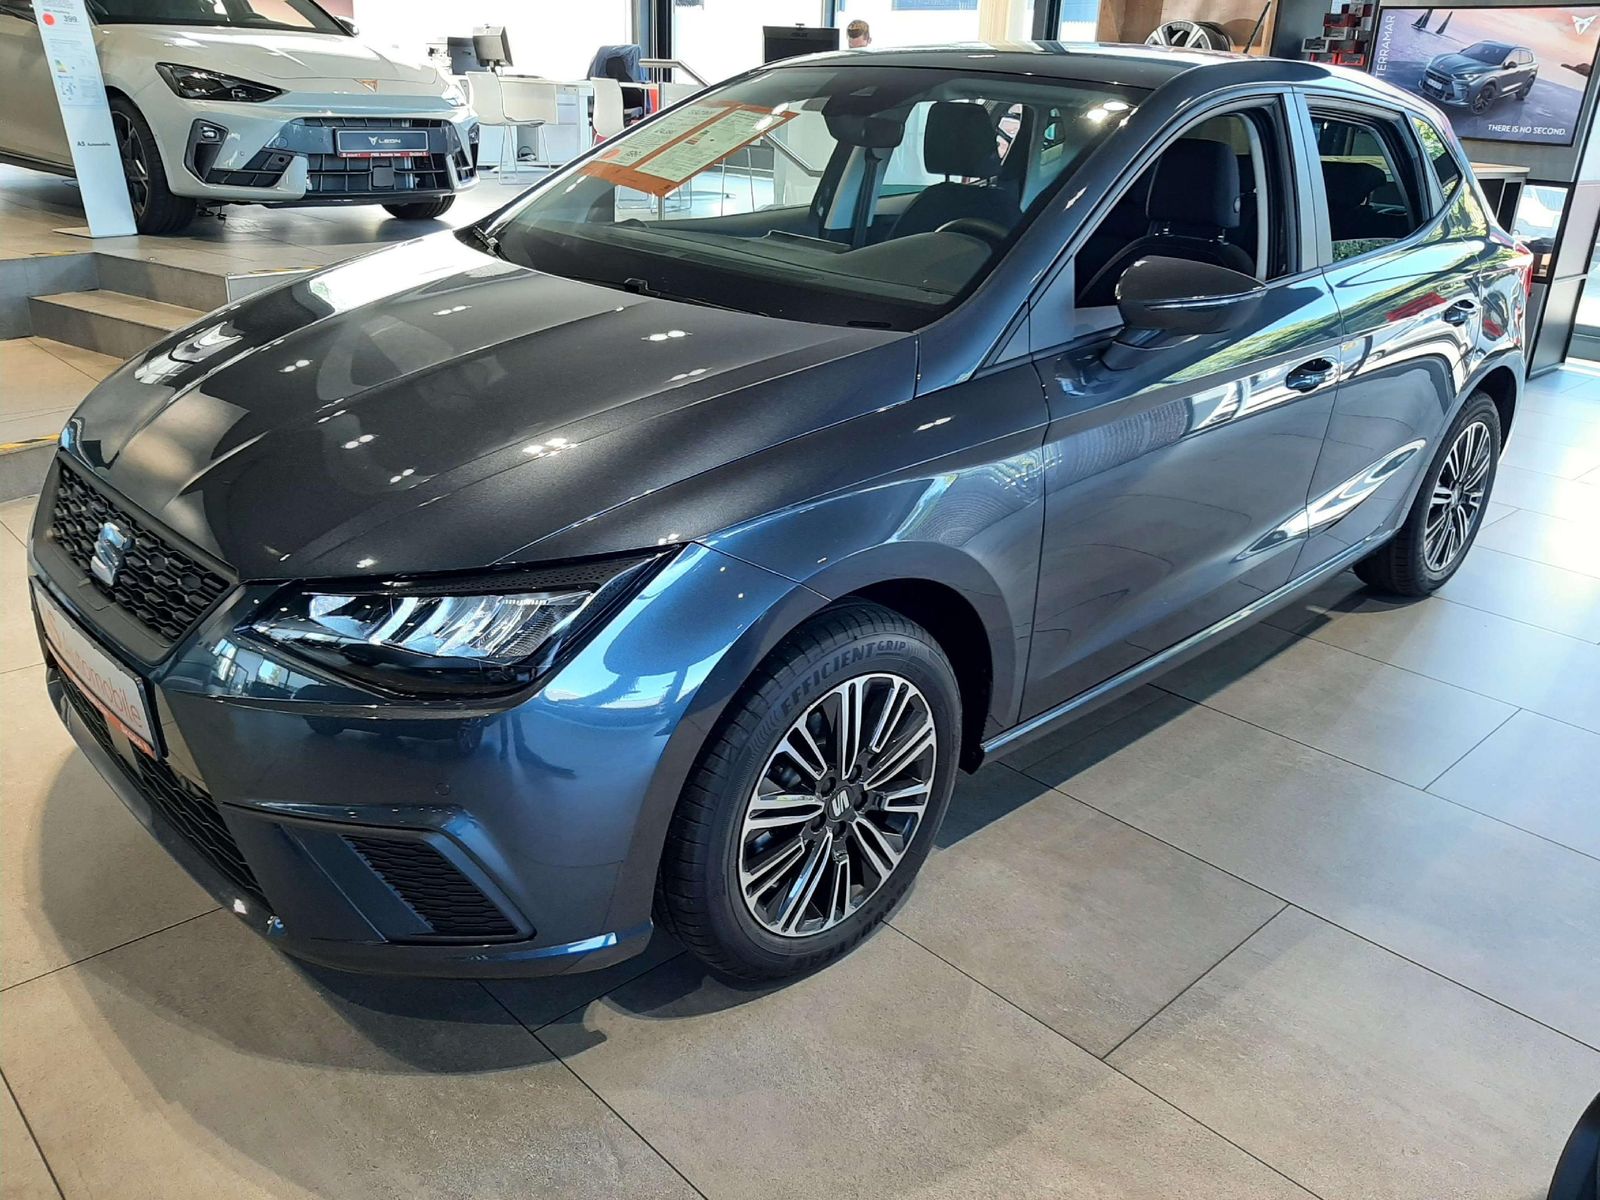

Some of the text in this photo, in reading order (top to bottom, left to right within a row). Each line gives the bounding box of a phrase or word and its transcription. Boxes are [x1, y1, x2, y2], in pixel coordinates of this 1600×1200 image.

[1375, 15, 1396, 78] TERRAMAR
[1488, 124, 1511, 133] THERE
[1511, 125, 1519, 133] IS
[1520, 126, 1532, 134] NO
